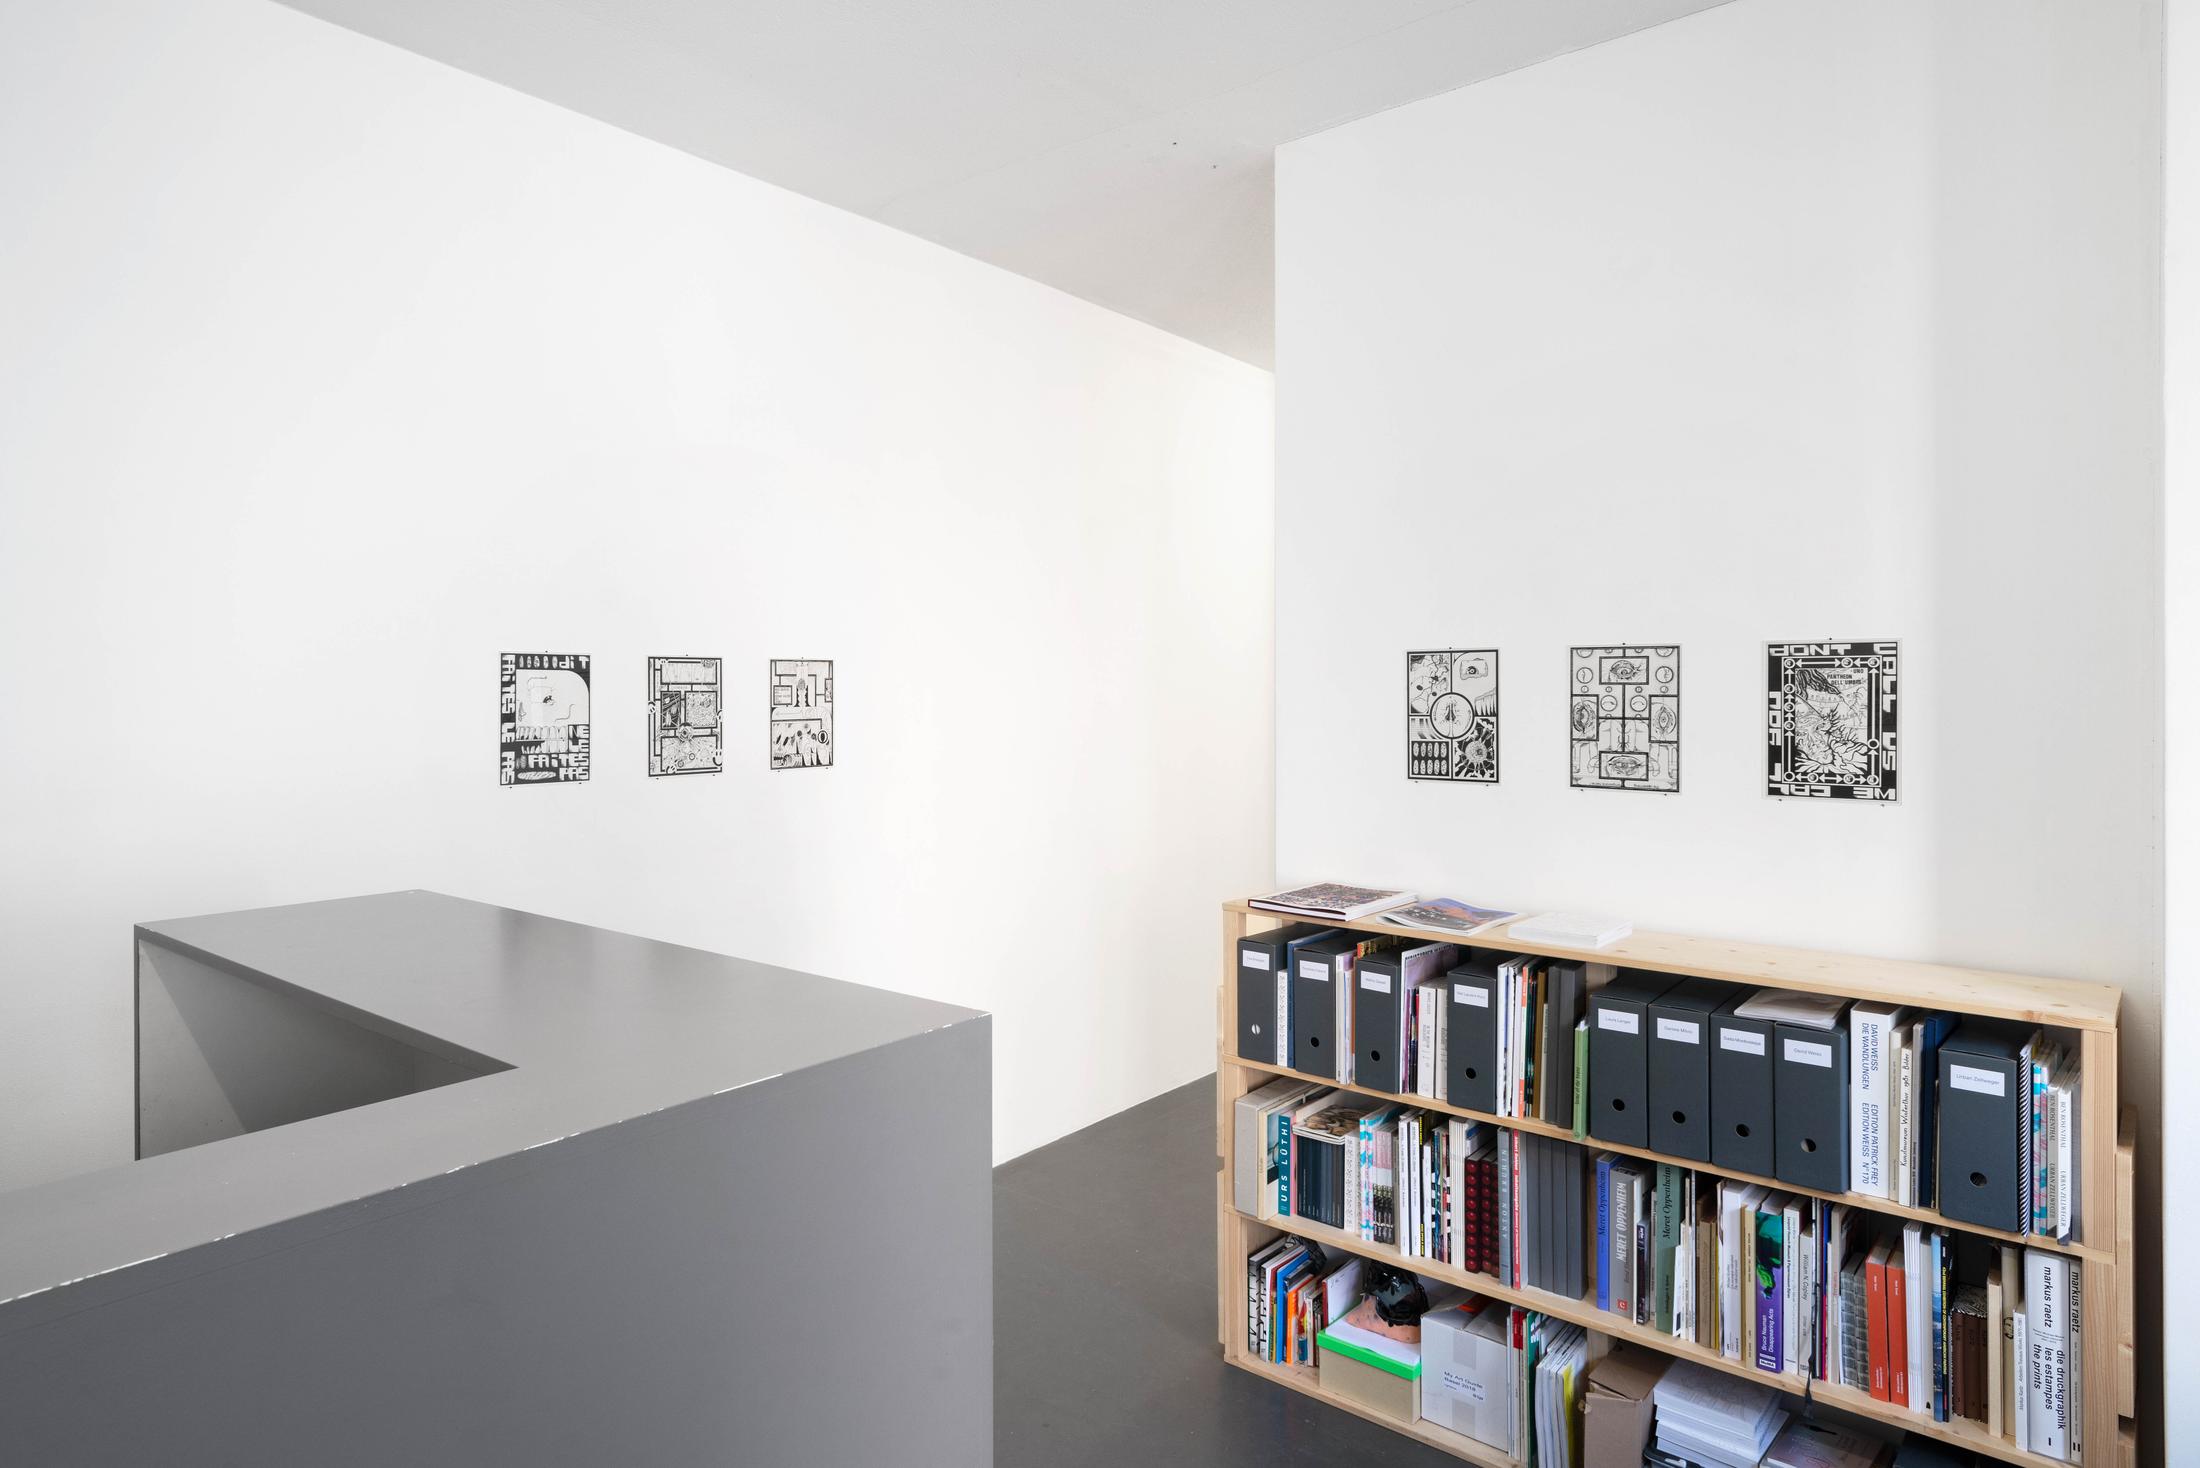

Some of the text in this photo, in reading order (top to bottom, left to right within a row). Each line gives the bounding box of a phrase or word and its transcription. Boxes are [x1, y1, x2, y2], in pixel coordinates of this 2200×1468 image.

[1598, 1171, 1607, 1236] Meret Oppenheim
[1616, 1182, 1626, 1262] MERET OPPENHEIM
[1662, 1167, 1672, 1239] Meret Oppenheim
[2044, 1266, 2053, 1328] markus raetz
[2071, 1271, 2080, 1306] markus
[2071, 1308, 2080, 1333] raetz
[2032, 1344, 2042, 1389] the prints
[2043, 1347, 2053, 1410] les estampes
[2055, 1350, 2066, 1429] die druckgraphik
